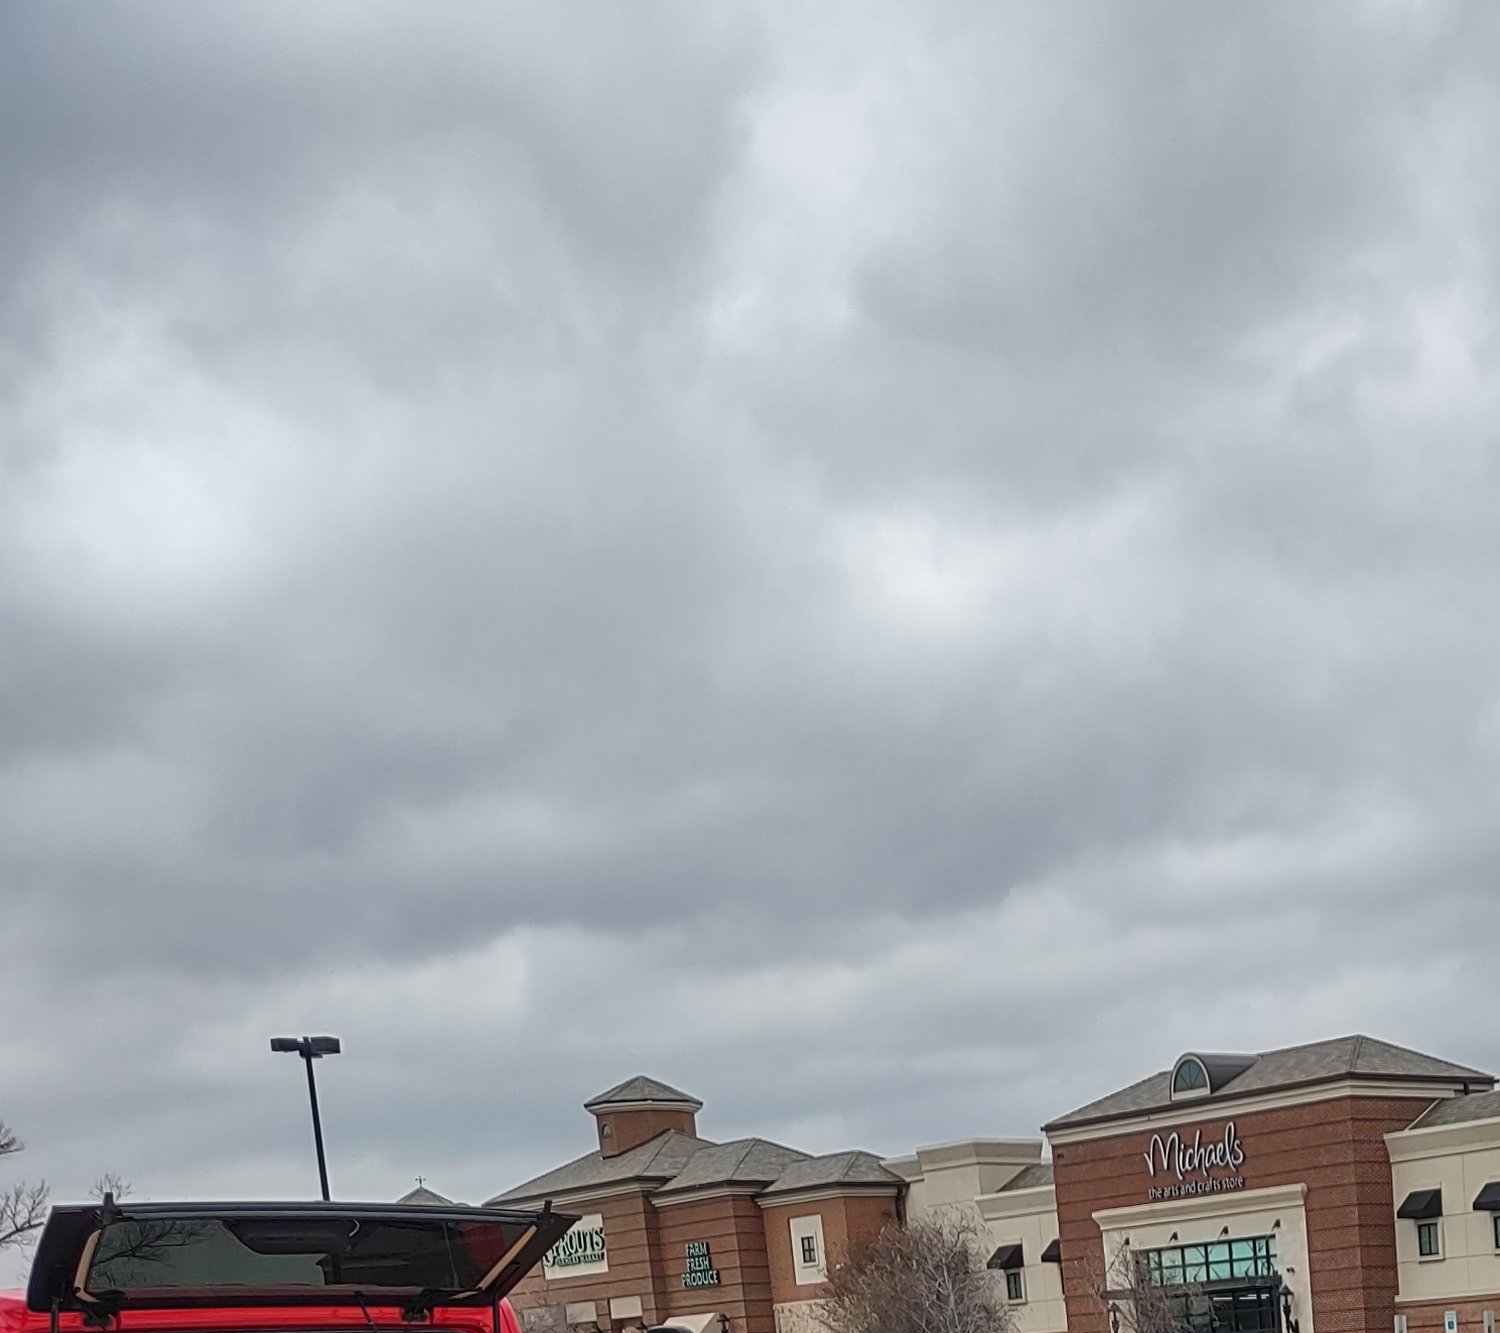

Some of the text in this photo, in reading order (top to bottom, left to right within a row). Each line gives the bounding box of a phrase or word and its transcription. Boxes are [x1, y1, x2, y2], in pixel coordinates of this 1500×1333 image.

[1143, 1121, 1244, 1180] Michaels
[1180, 1180, 1196, 1196] and
[1197, 1178, 1221, 1193] crafts
[1222, 1176, 1244, 1189] store
[685, 1241, 709, 1257] FARM
[686, 1256, 711, 1272] FRESH
[681, 1270, 719, 1288] PRODUCE
